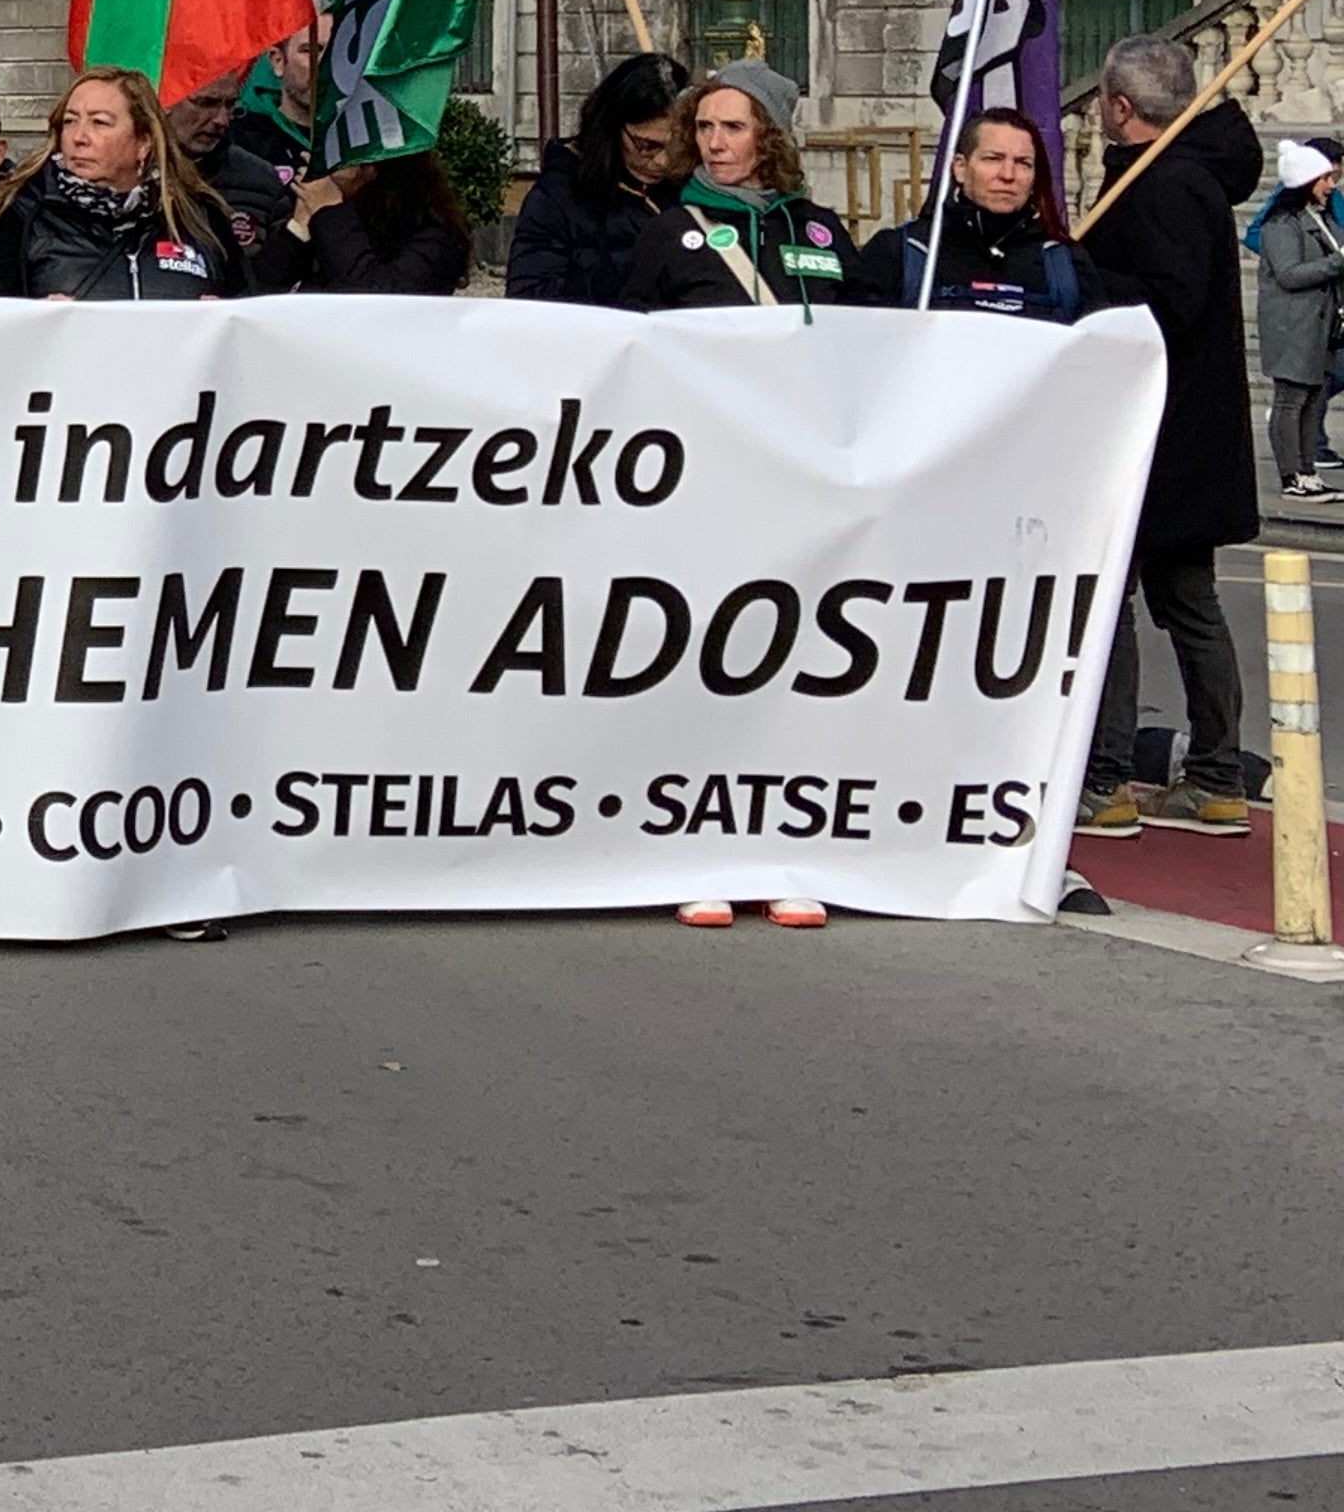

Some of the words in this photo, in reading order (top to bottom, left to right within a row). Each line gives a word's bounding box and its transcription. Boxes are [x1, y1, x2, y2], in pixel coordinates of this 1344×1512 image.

[15, 390, 685, 506] indartzeko
[469, 574, 1099, 702] ADOSTU!
[28, 777, 211, 862] CCOO
[272, 771, 577, 837] STEILAS
[640, 773, 876, 840] SATSE
[946, 780, 1050, 847] ES
